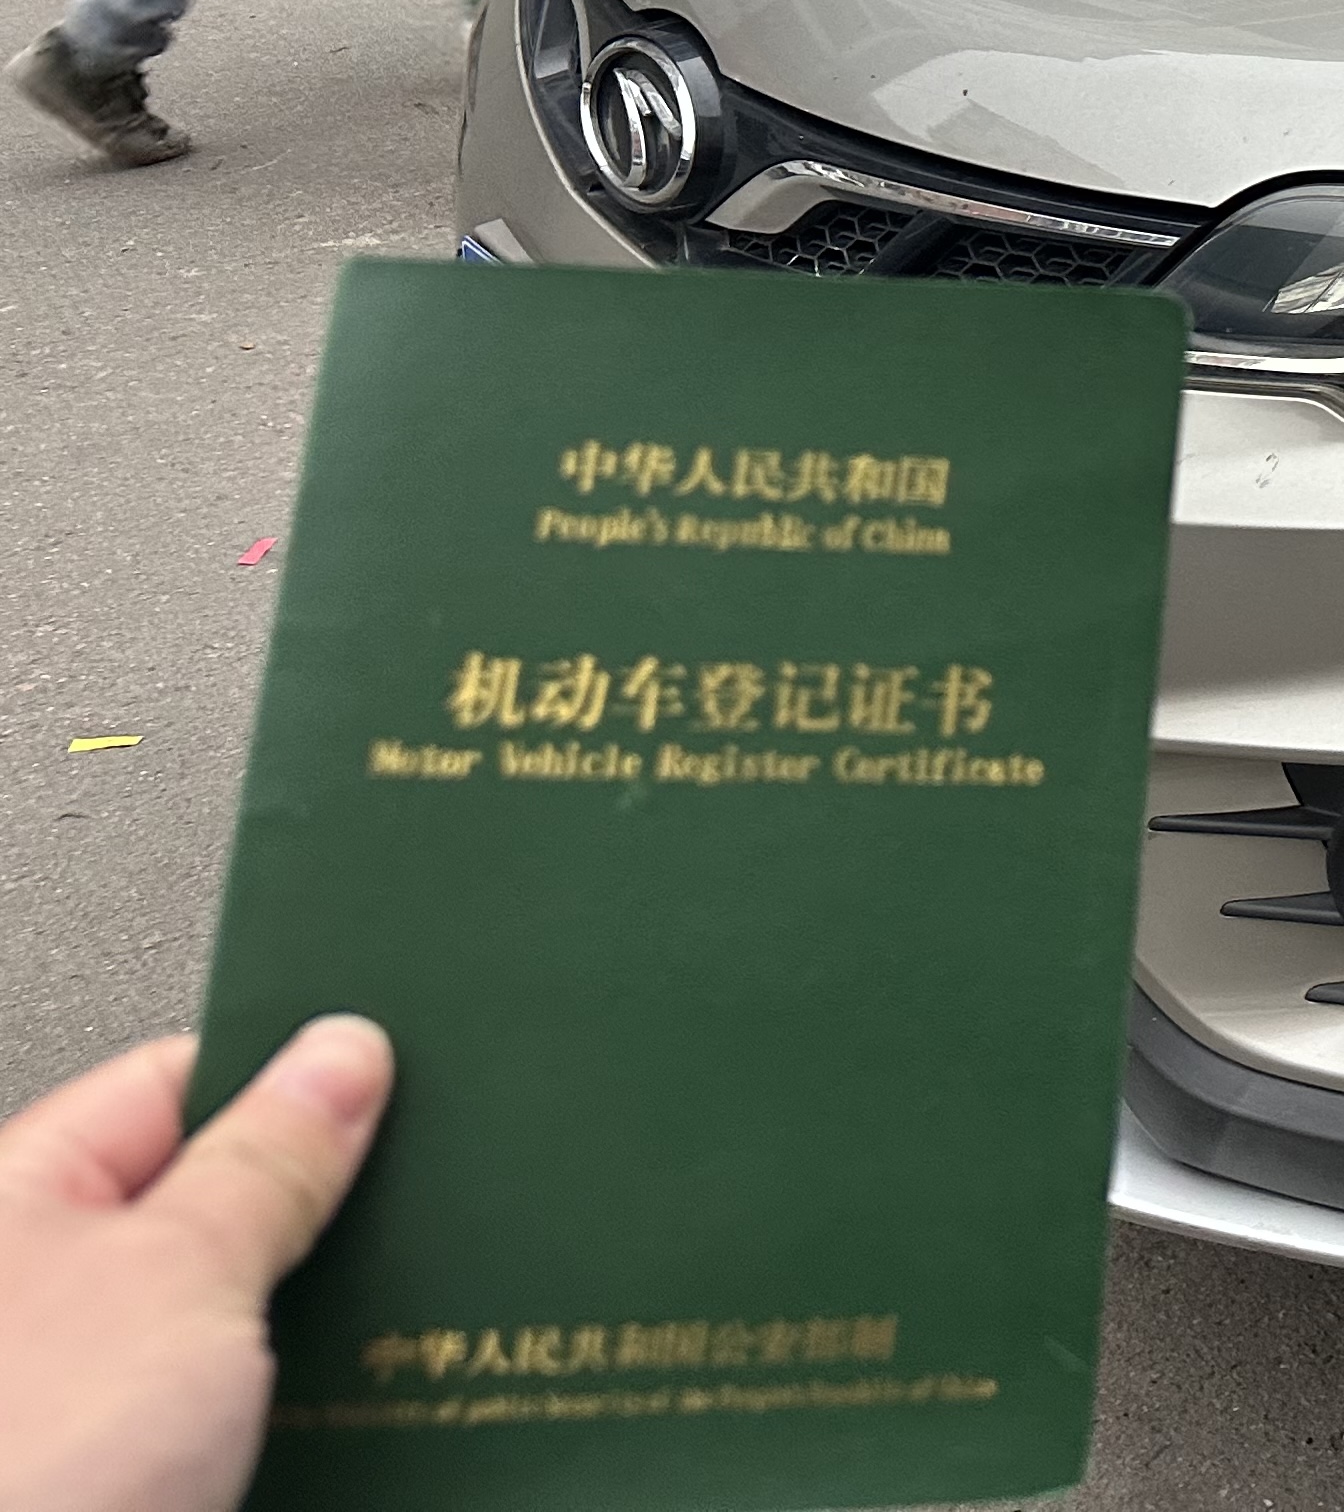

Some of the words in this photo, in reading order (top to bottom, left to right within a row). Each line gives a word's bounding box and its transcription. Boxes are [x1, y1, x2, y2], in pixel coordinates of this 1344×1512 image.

[558, 436, 951, 507] 中华人民共和国
[534, 506, 668, 549] People's
[820, 517, 856, 552] of
[860, 518, 951, 555] China
[447, 649, 997, 739] 机动车登记证书
[368, 738, 482, 781] Motor
[498, 742, 642, 781] Vehicle
[654, 744, 821, 784] Register
[832, 745, 1046, 786] Certificate
